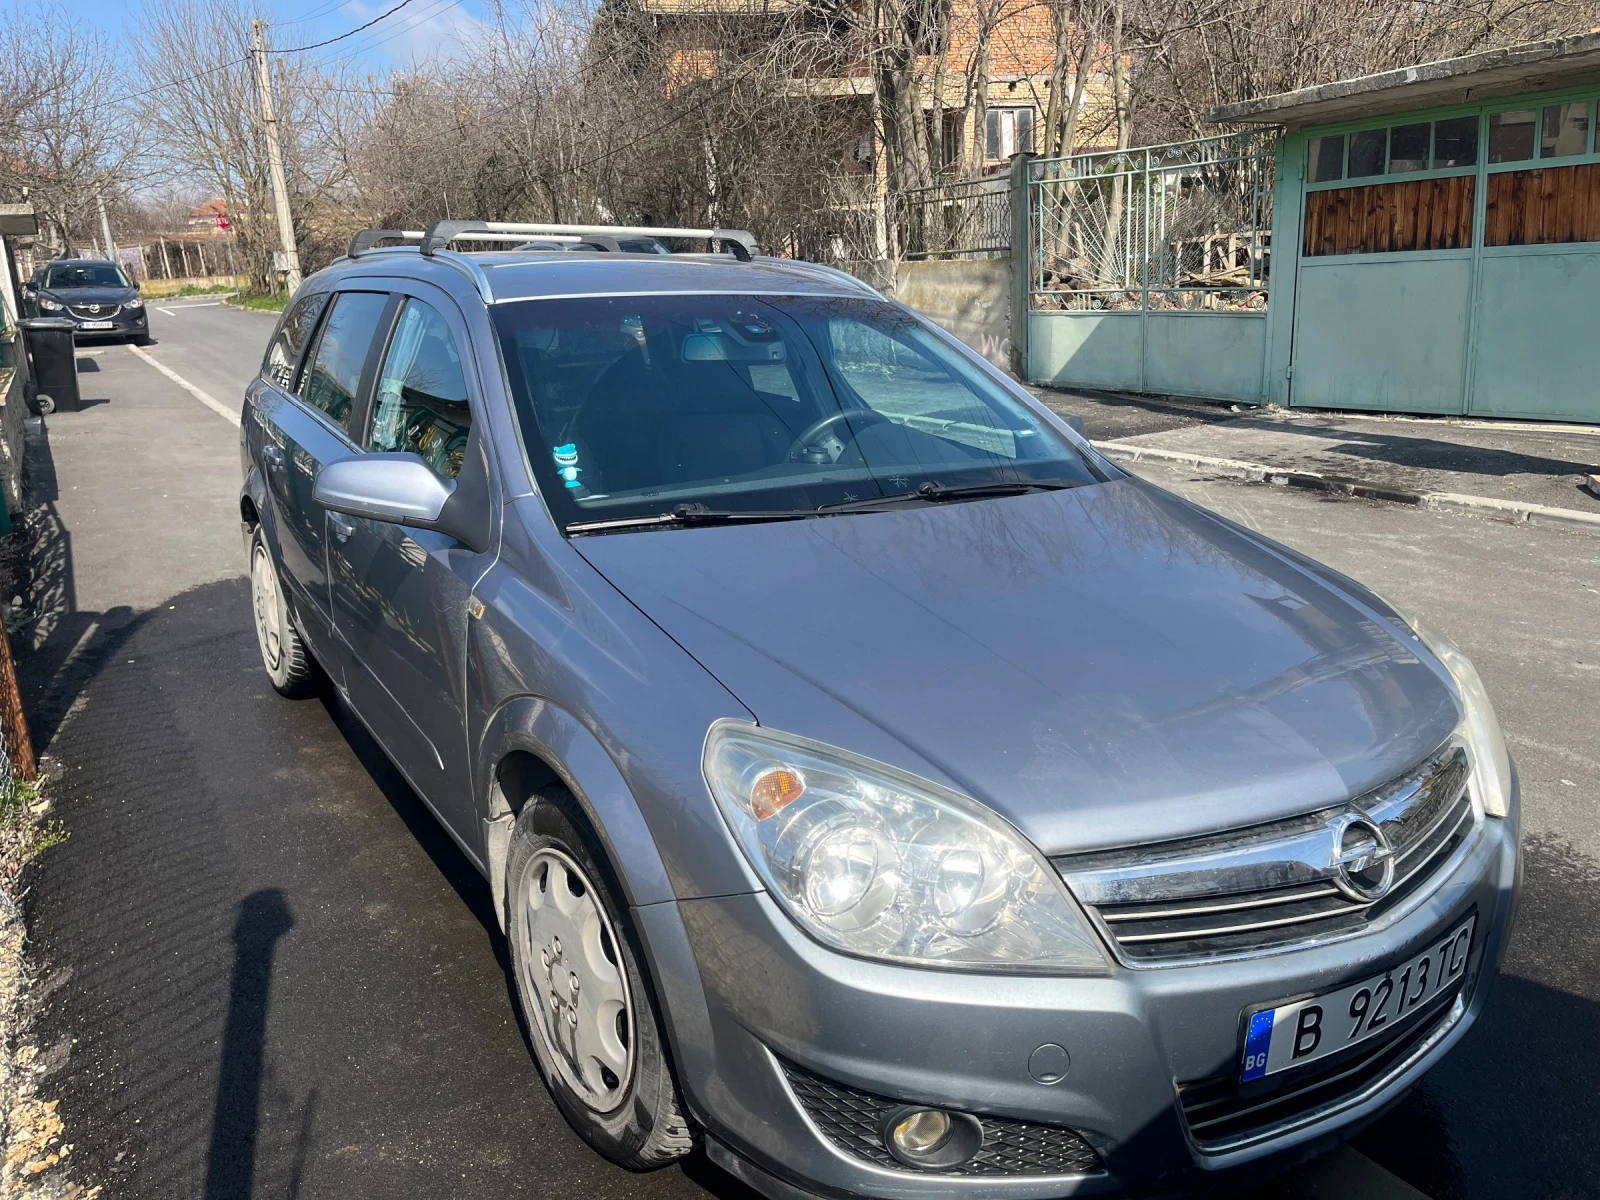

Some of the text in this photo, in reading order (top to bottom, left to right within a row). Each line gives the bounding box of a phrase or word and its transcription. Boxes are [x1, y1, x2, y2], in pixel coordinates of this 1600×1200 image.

[1291, 926, 1469, 1061] B 9213 TC
[1245, 1052, 1266, 1071] BG
